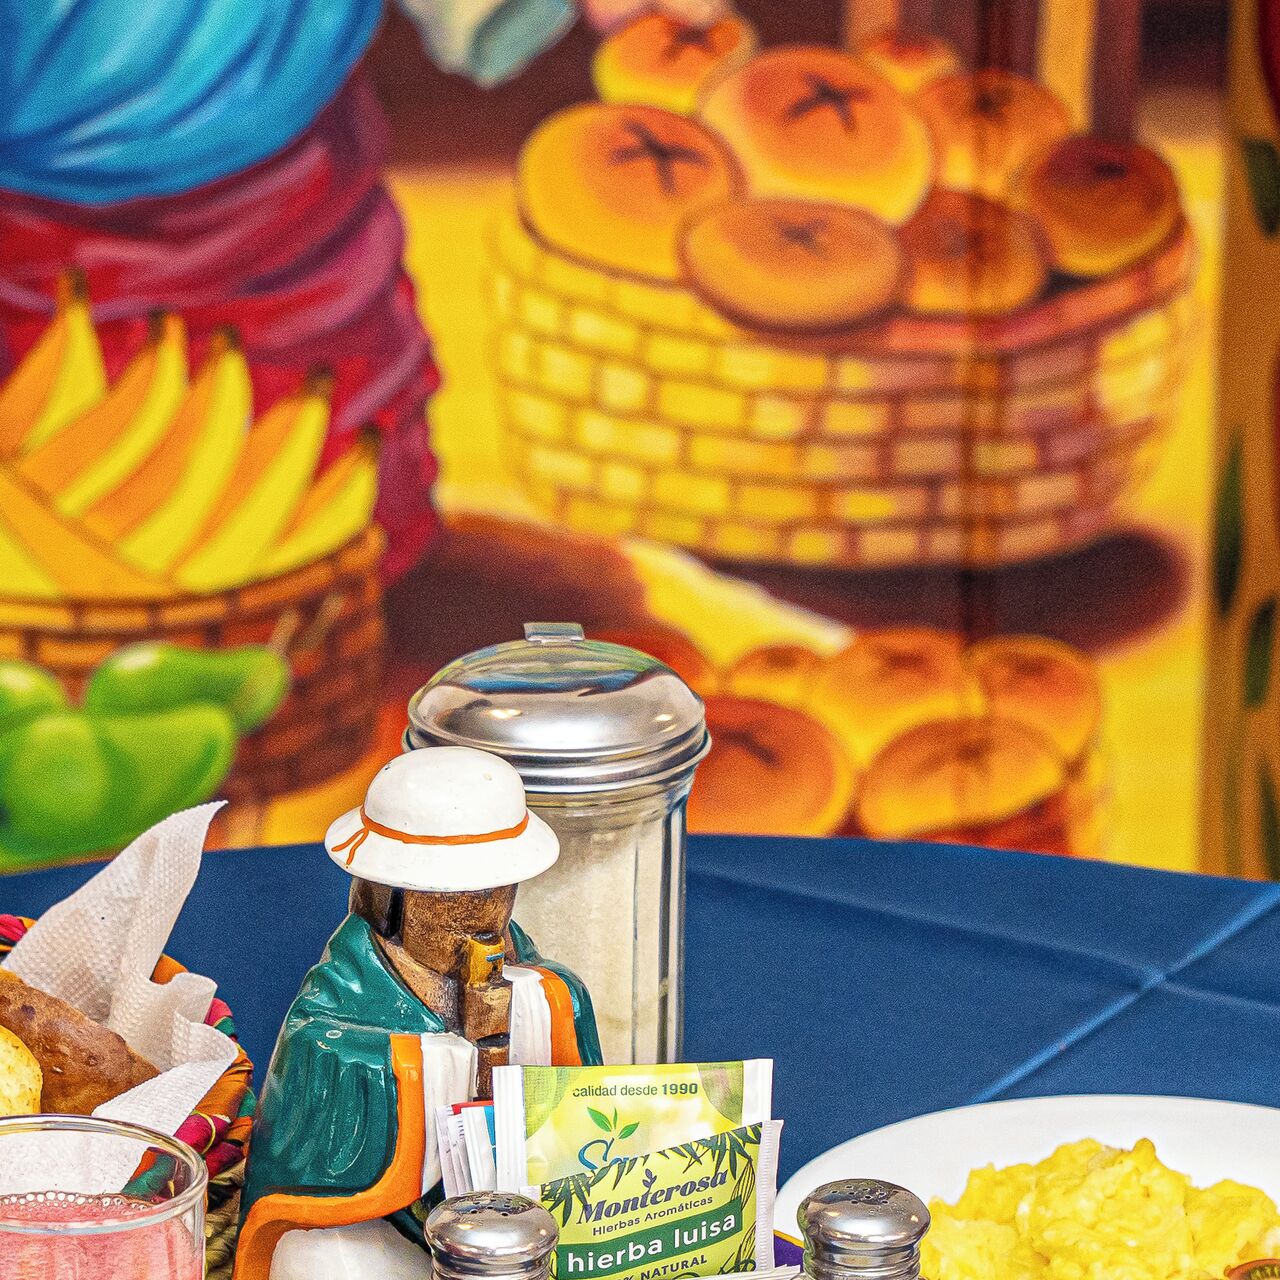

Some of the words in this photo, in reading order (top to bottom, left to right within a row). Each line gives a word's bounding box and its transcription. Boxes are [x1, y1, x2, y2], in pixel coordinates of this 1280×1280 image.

[572, 1085, 617, 1097] calidad
[620, 1084, 658, 1096] desde
[661, 1082, 698, 1095] 1990
[576, 1168, 729, 1225] Monterosa
[592, 1216, 640, 1236] Hierbas
[644, 1196, 713, 1222] Aromáticas
[567, 1238, 663, 1273] hierba
[674, 1213, 736, 1248] luisa
[640, 1254, 708, 1280] NATURAL
